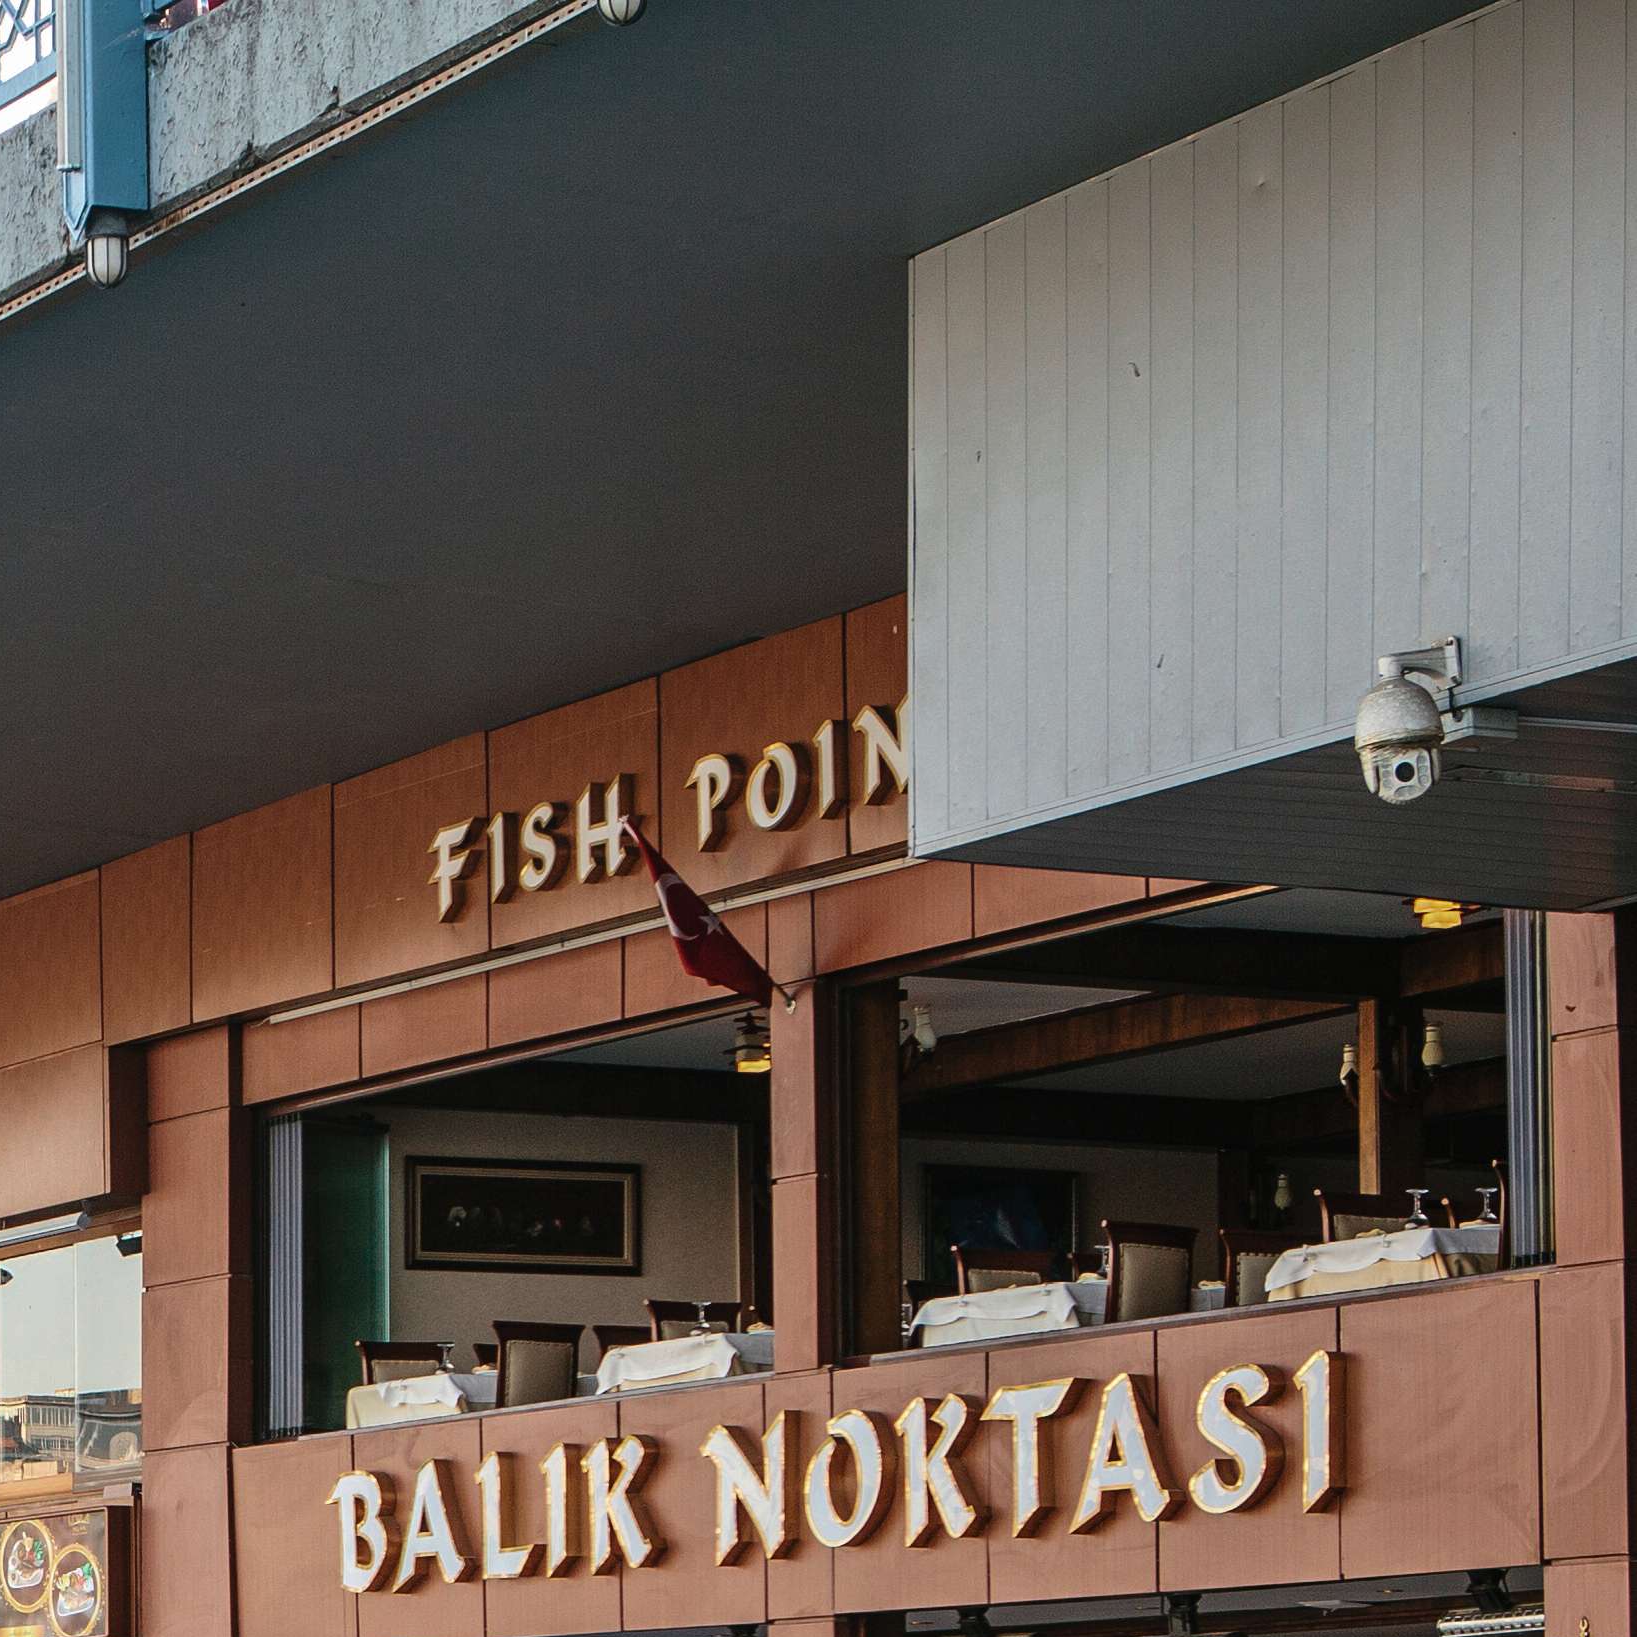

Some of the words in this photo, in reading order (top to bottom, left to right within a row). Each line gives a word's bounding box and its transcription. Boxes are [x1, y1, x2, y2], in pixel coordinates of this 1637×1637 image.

[427, 774, 629, 922] FISH
[325, 1435, 655, 1593] BALIK
[700, 1350, 1333, 1567] NOKTASI
